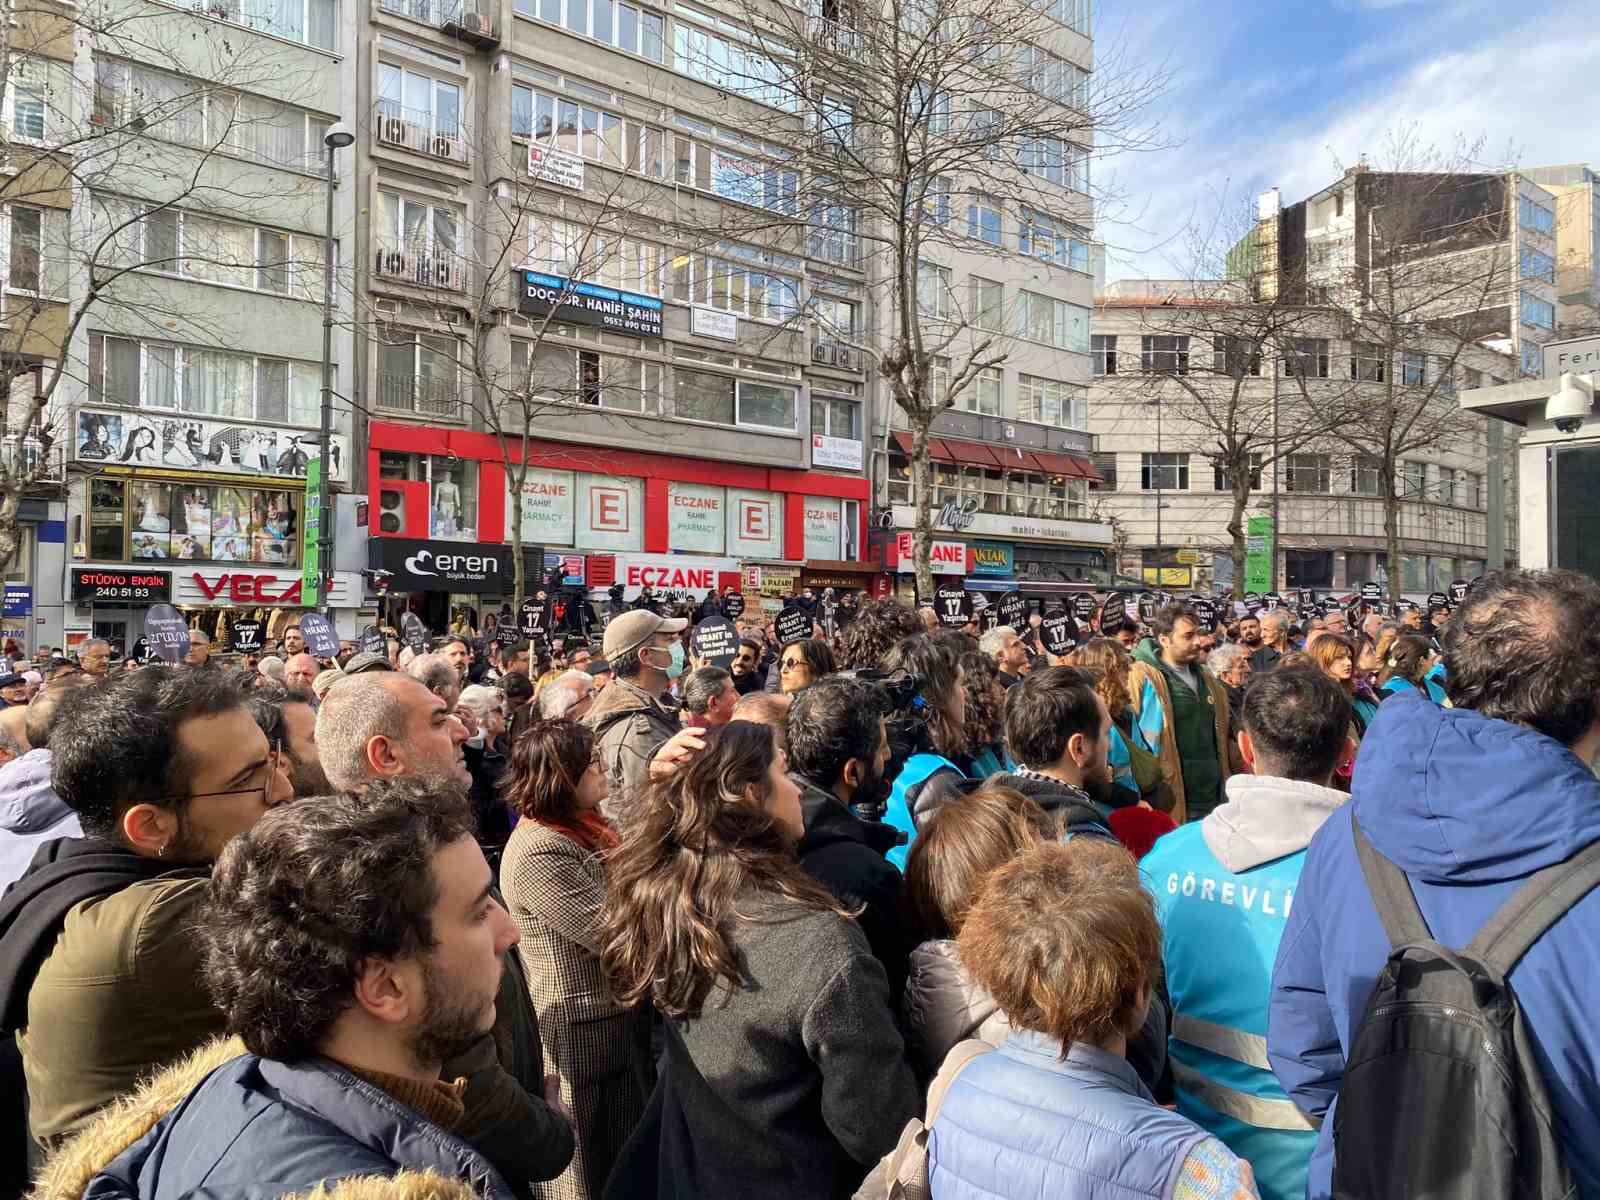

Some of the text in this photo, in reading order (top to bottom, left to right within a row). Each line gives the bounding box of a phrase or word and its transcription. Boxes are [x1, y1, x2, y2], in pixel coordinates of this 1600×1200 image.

[586, 299, 624, 316] HANİFİ
[627, 306, 661, 324] ŞAHİN
[514, 482, 567, 497] CZANE
[673, 496, 719, 510] ECZANE
[435, 554, 498, 573] eren
[81, 572, 164, 587] STÜDYO ENGİN
[628, 566, 713, 589] ECZANE
[96, 586, 149, 598] 240 51 93
[939, 590, 965, 598] Cinayet
[522, 604, 544, 612] Cinayet
[945, 599, 961, 615] 17
[1001, 600, 1025, 615] HRANT
[526, 613, 540, 627] 17
[778, 618, 800, 630] HRANT
[234, 623, 260, 632] Cinayet
[304, 625, 330, 635] HRANT
[1050, 625, 1066, 643] 17
[240, 631, 255, 643] 17
[697, 630, 733, 643] HRANT in
[1167, 872, 1294, 918] GÖREVLİ
